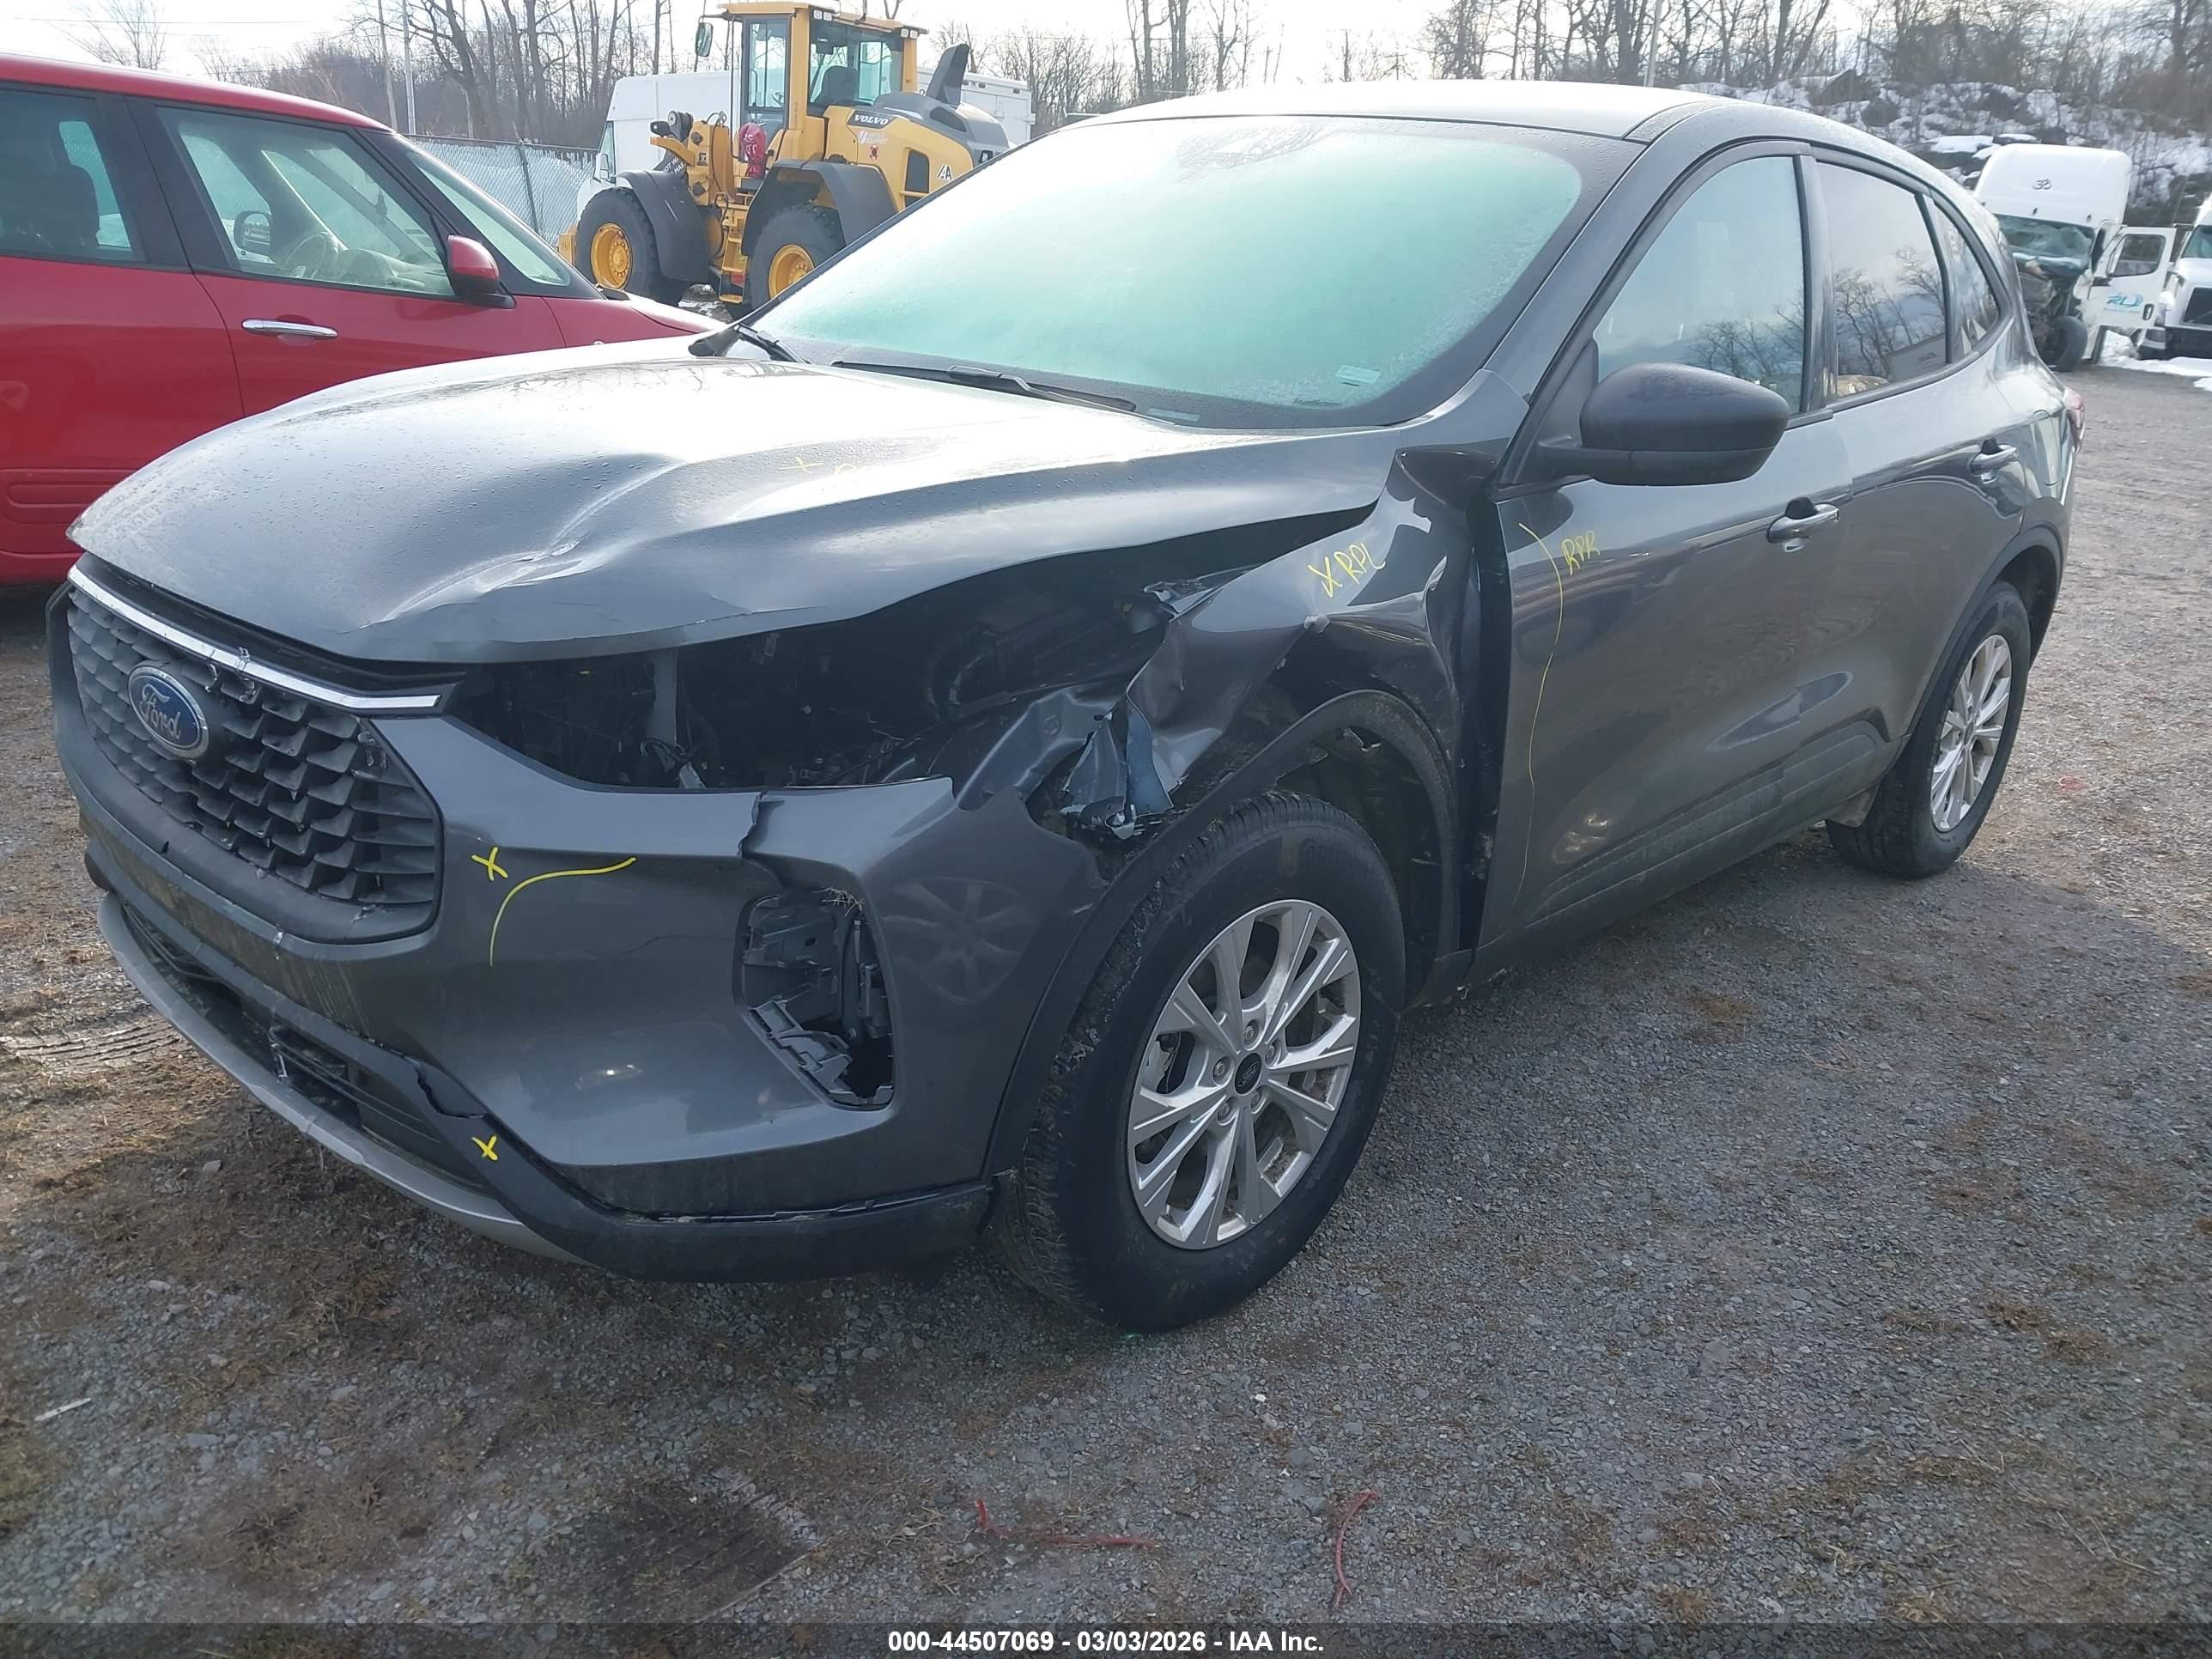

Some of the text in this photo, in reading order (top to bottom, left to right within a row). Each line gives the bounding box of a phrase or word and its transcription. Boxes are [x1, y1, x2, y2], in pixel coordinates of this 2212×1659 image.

[854, 114, 889, 125] VOLVO
[1334, 543, 1386, 585] RPL
[1561, 530, 1601, 576] RPR
[139, 684, 182, 740] Ford
